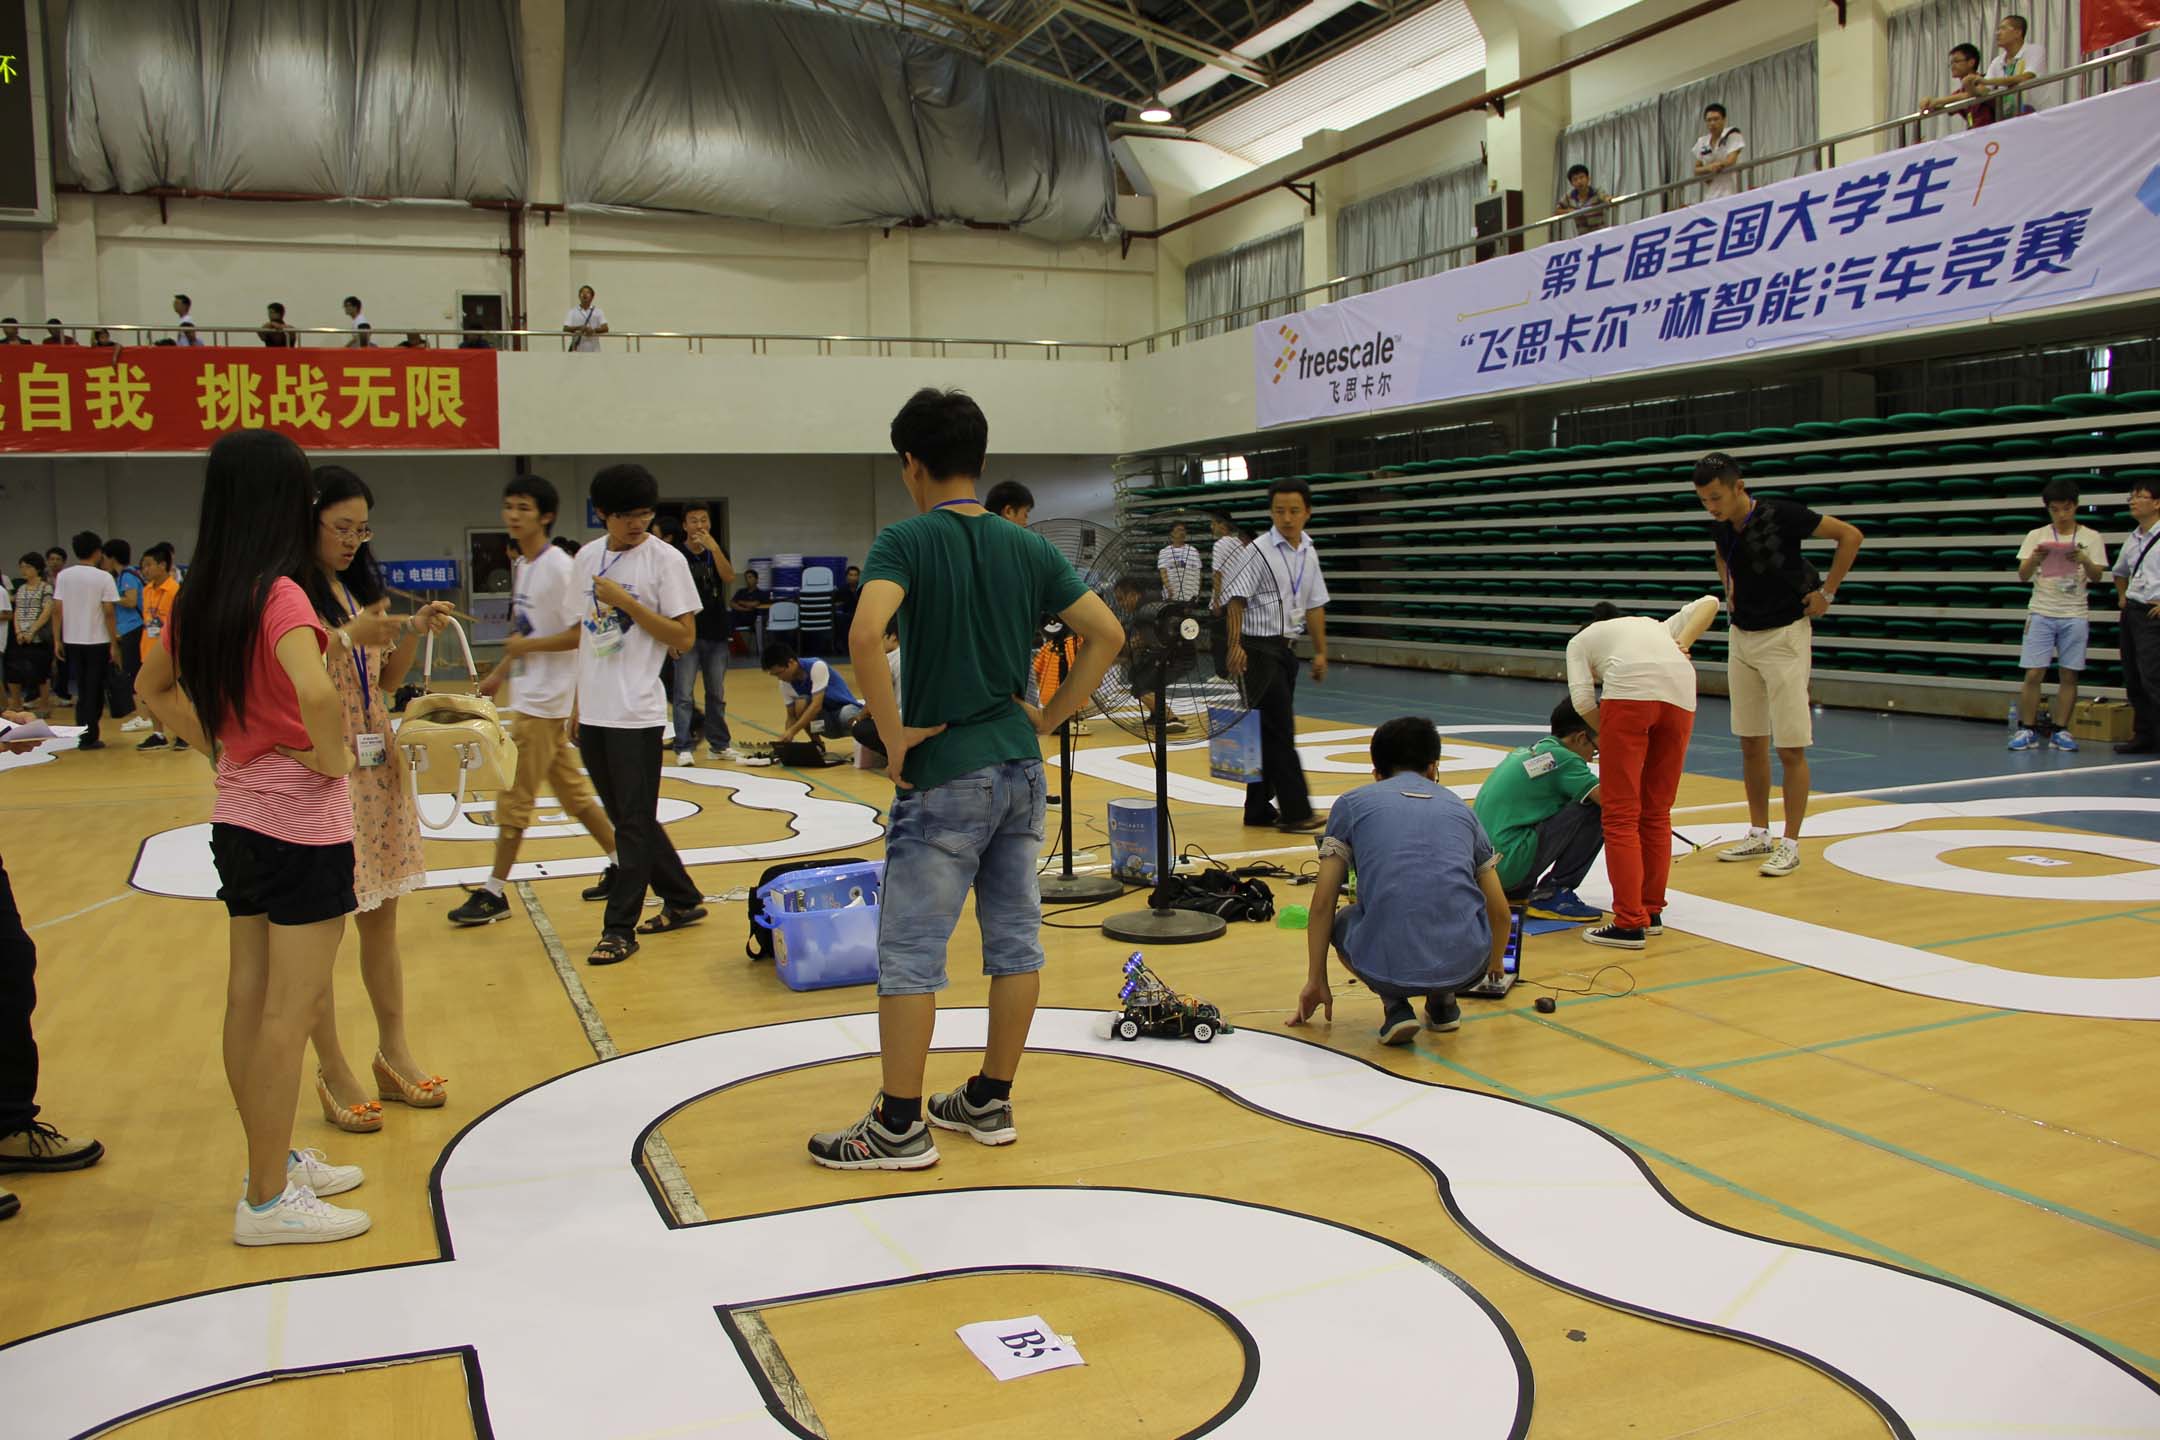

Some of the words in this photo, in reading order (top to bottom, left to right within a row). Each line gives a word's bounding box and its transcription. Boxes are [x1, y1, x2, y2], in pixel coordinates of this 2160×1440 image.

[1541, 157, 1958, 301] 第七届全国大学生
[1460, 208, 2094, 374] “飞思卡尔”杯智能汽车竞赛
[1299, 331, 1395, 380] freescale
[0, 361, 154, 432] 自我
[196, 362, 467, 430] 挑战无限
[1328, 371, 1392, 404] 飞思卡尔
[997, 1328, 1061, 1359] B5
